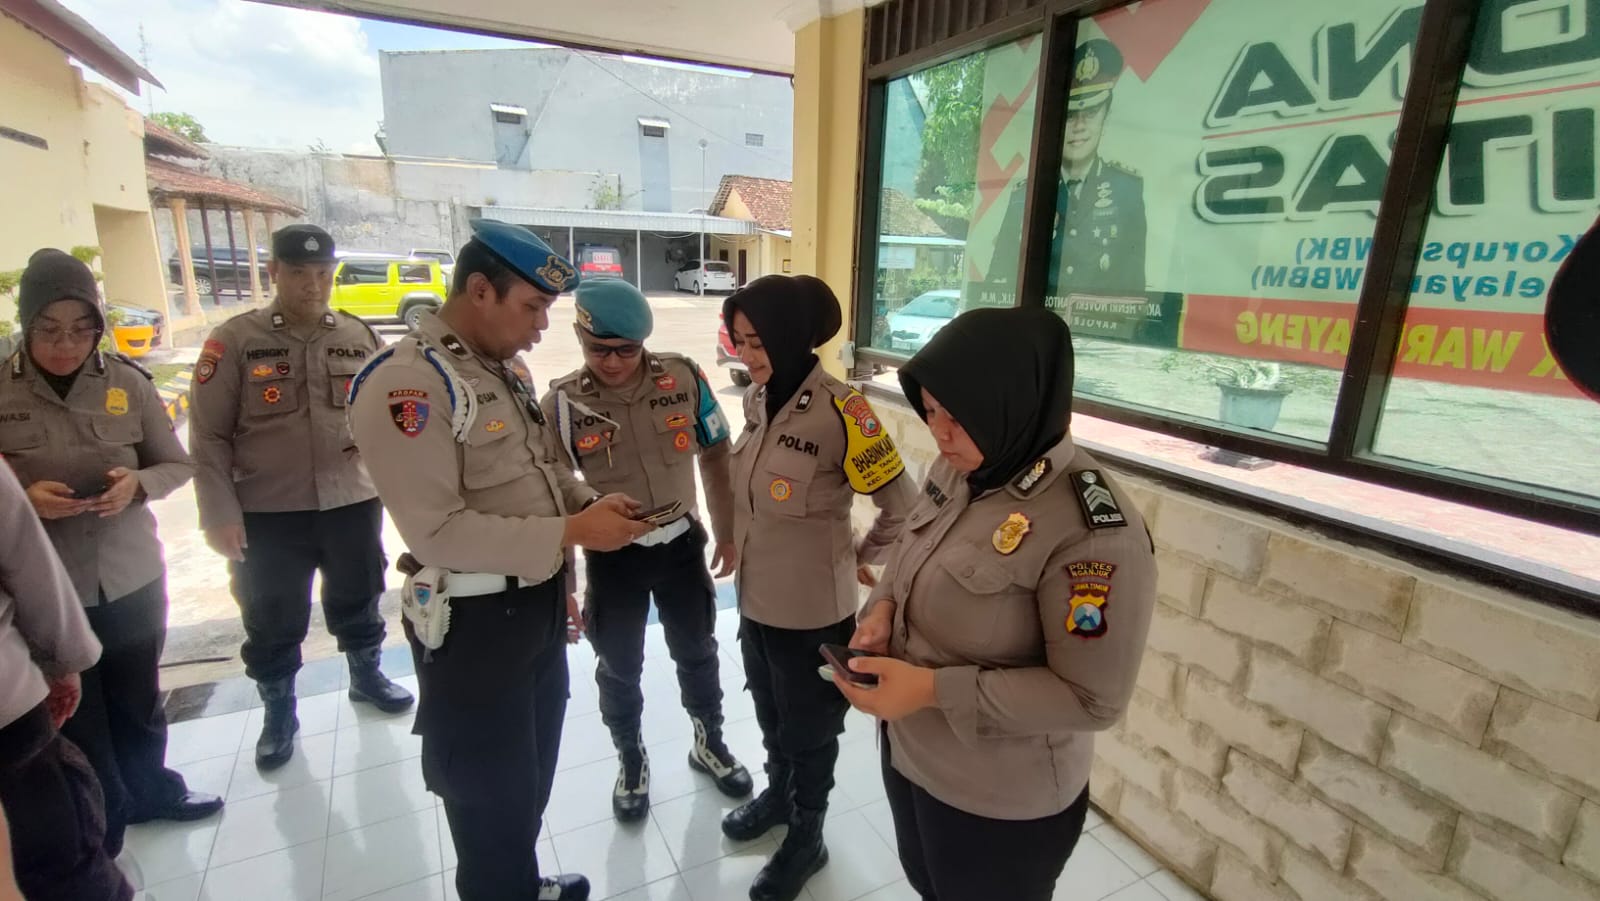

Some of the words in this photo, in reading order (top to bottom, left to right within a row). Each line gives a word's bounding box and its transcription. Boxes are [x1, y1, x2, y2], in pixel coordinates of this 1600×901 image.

[247, 348, 289, 360] HENGKY
[327, 348, 366, 358] POLRI
[649, 392, 689, 410] POLRI
[777, 434, 819, 457] POLRI
[1069, 562, 1112, 572] POLRES
